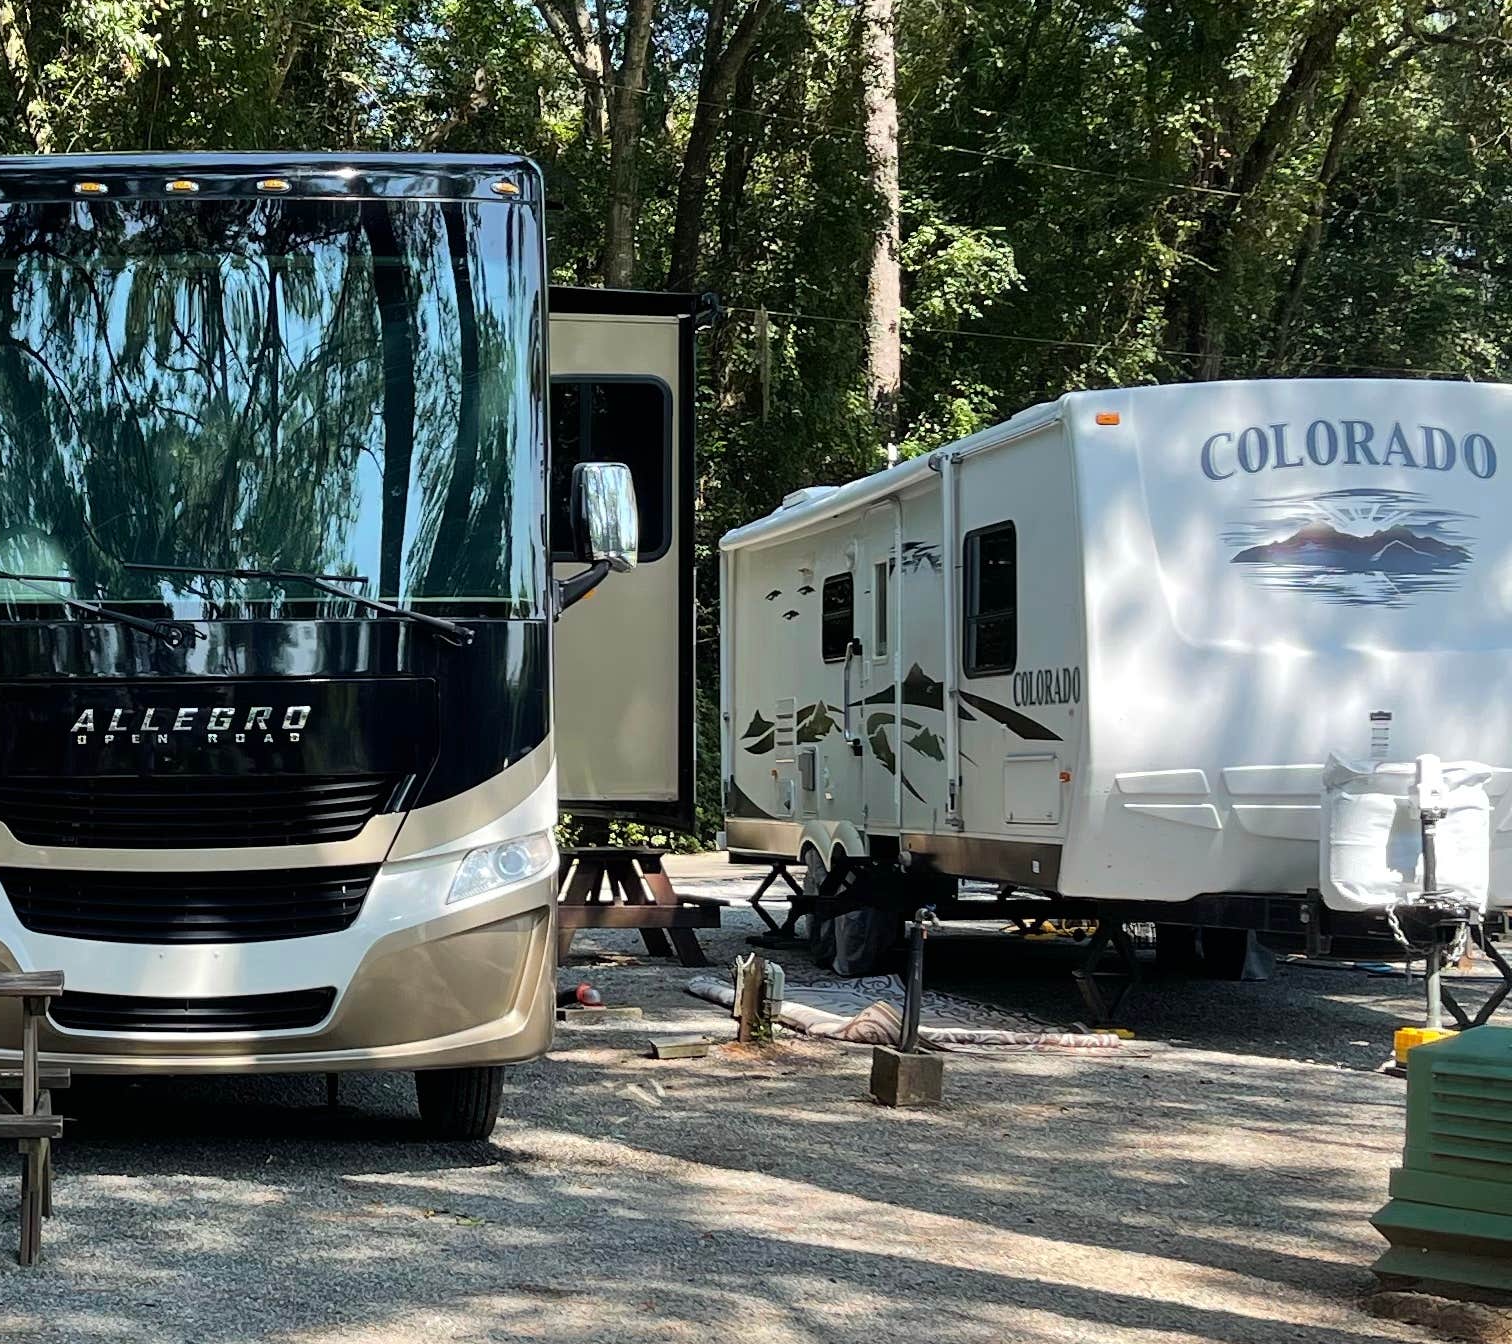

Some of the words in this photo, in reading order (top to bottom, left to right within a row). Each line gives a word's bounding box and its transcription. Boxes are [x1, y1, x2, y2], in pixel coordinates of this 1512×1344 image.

[1200, 419, 1498, 480] COLORADO
[1013, 666, 1081, 706] COLORADO
[70, 706, 311, 732] ALLEGRO
[77, 734, 168, 745] OPEN
[207, 732, 300, 743] ROAD
